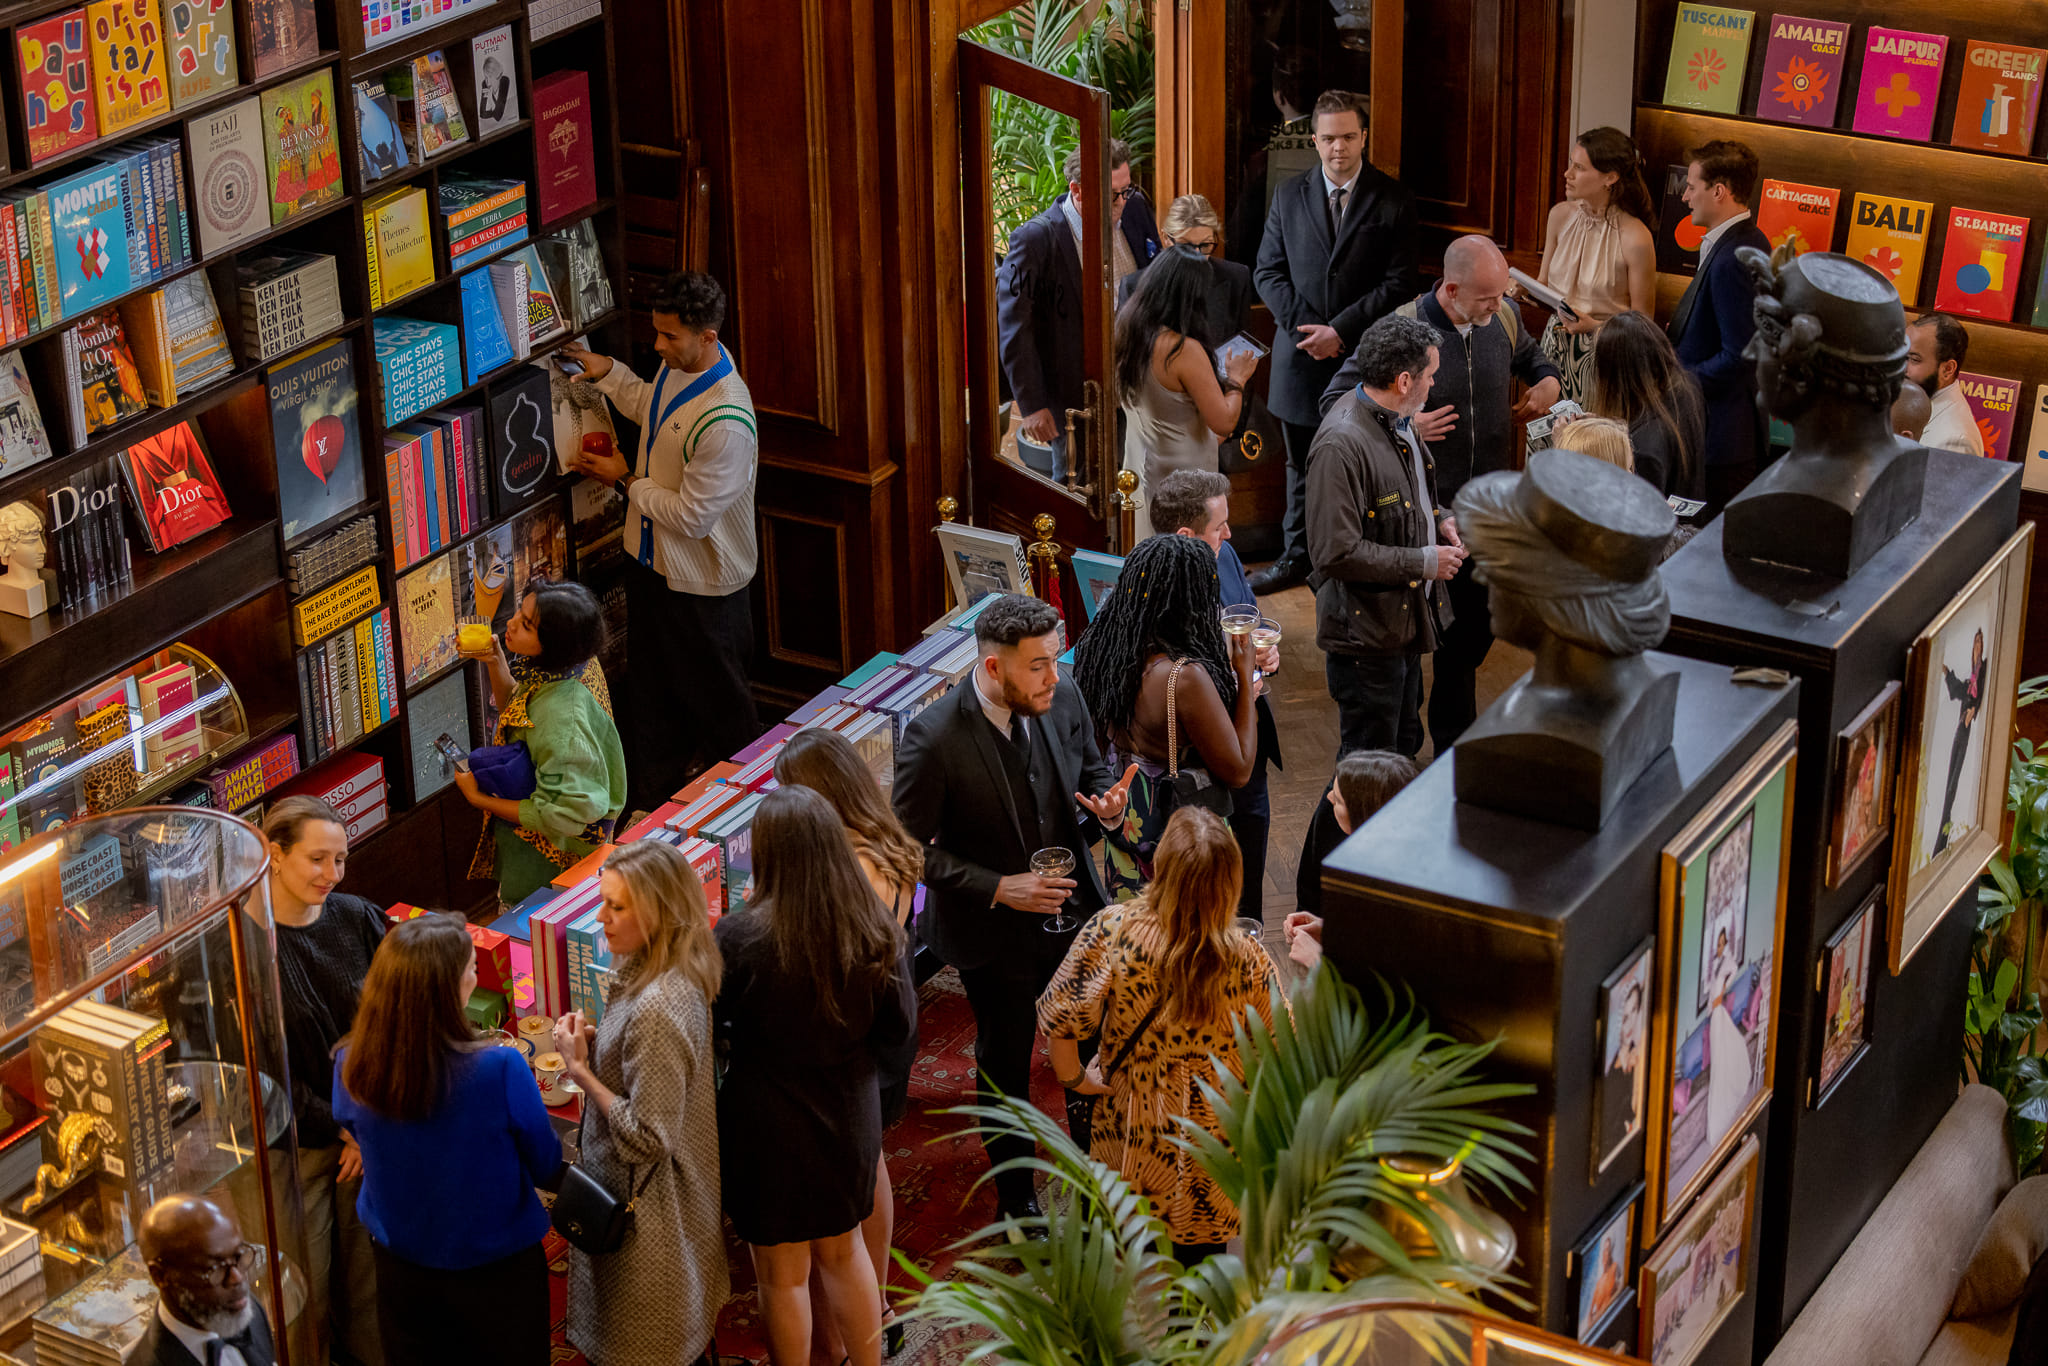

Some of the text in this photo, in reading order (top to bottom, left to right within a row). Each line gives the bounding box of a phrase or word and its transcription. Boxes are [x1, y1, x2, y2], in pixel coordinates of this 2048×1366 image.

[1682, 9, 1748, 30] TUSCANY
[1774, 23, 1843, 46] AMALFI
[474, 33, 507, 50] PUTMAN
[1812, 43, 1841, 55] COAST
[1870, 36, 1942, 61] JAIPUR
[1970, 48, 2041, 73] GREEK
[2002, 70, 2039, 81] ISLANDS
[180, 77, 211, 99] style
[211, 113, 238, 137] HAJJ
[542, 96, 581, 120] HAGGADAH
[280, 124, 325, 151] BEYOND
[161, 156, 176, 202] DUBAI
[54, 174, 117, 219] MONTE
[87, 195, 119, 218] CARLO
[151, 160, 171, 266] MOON PARADISE
[464, 189, 518, 217] MISSION POSSIBLE
[1766, 188, 1831, 208] CARTAGENA
[1798, 203, 1831, 216] GRACE
[119, 171, 140, 277] TURQUOISE COAST
[141, 164, 160, 270] HAMPTONS PRIVATE
[180, 211, 191, 257] PRIVATE
[380, 213, 394, 226] Site
[382, 225, 411, 243] Themes
[470, 219, 517, 247] AL WASL PLAZA
[482, 211, 502, 226] TERRA
[1857, 200, 1926, 234] BALI
[1955, 216, 2023, 236] ST.BARTHS
[5, 220, 20, 291] CARTAGENA
[29, 208, 49, 318] TUSCANY MARVEL
[137, 230, 150, 275] GLAM
[385, 235, 427, 258] Architecture
[16, 213, 37, 319] PUNTA DEL ESTE
[257, 272, 300, 302] KEN FULK
[259, 286, 302, 316] KEN FULK
[260, 301, 303, 330] KEN FULK
[262, 315, 305, 345] KEN FULK
[83, 347, 113, 372] d'Or
[263, 328, 306, 358] KEN FULK
[390, 336, 443, 370] CHIC STAYS
[271, 352, 350, 400] OUIS VUITTON
[391, 349, 444, 383] CHIC STAYS
[392, 362, 445, 396] CHIC STAYS
[281, 376, 338, 411] VIRGIL ABLOH
[392, 375, 446, 409] CHIC STAYS
[394, 388, 447, 422] CHIC STAYS
[1960, 380, 2015, 403] MALFI
[1983, 400, 2012, 412] COAST
[156, 484, 203, 515] Dior
[390, 461, 404, 547] NEW YORK
[402, 451, 415, 528] SWANS
[47, 482, 119, 534] Dior
[1015, 546, 1030, 583] SICILY
[303, 573, 370, 615] THE RACE OF GENTLEMEN
[305, 586, 372, 629] THE RACE OF GENTLEMEN
[307, 599, 374, 641] THE RACE OF GENTLEMEN
[336, 635, 349, 694] KEN FULK
[366, 629, 374, 665] TRAVEL
[370, 682, 378, 719] DESIGN
[374, 624, 388, 700] CHIC STAYS
[383, 619, 398, 709] VILLEGGIATURA
[329, 653, 343, 733] UZBEKISTAN
[317, 710, 325, 748] GUIDE
[858, 727, 891, 764] AIRO
[26, 736, 64, 758] MYKONOS
[224, 740, 289, 788] AMALFI COAST
[226, 752, 291, 800] AMALFI COAST
[228, 765, 293, 813] AMALFI COAST
[88, 845, 112, 867] COAST
[90, 858, 114, 880] COAST
[91, 871, 116, 893] COAST
[568, 940, 582, 994] MONTE
[124, 1050, 146, 1179] JEWELRY GUIDE
[146, 1117, 159, 1169] GUIDE
[159, 1107, 172, 1160] GUIDE
